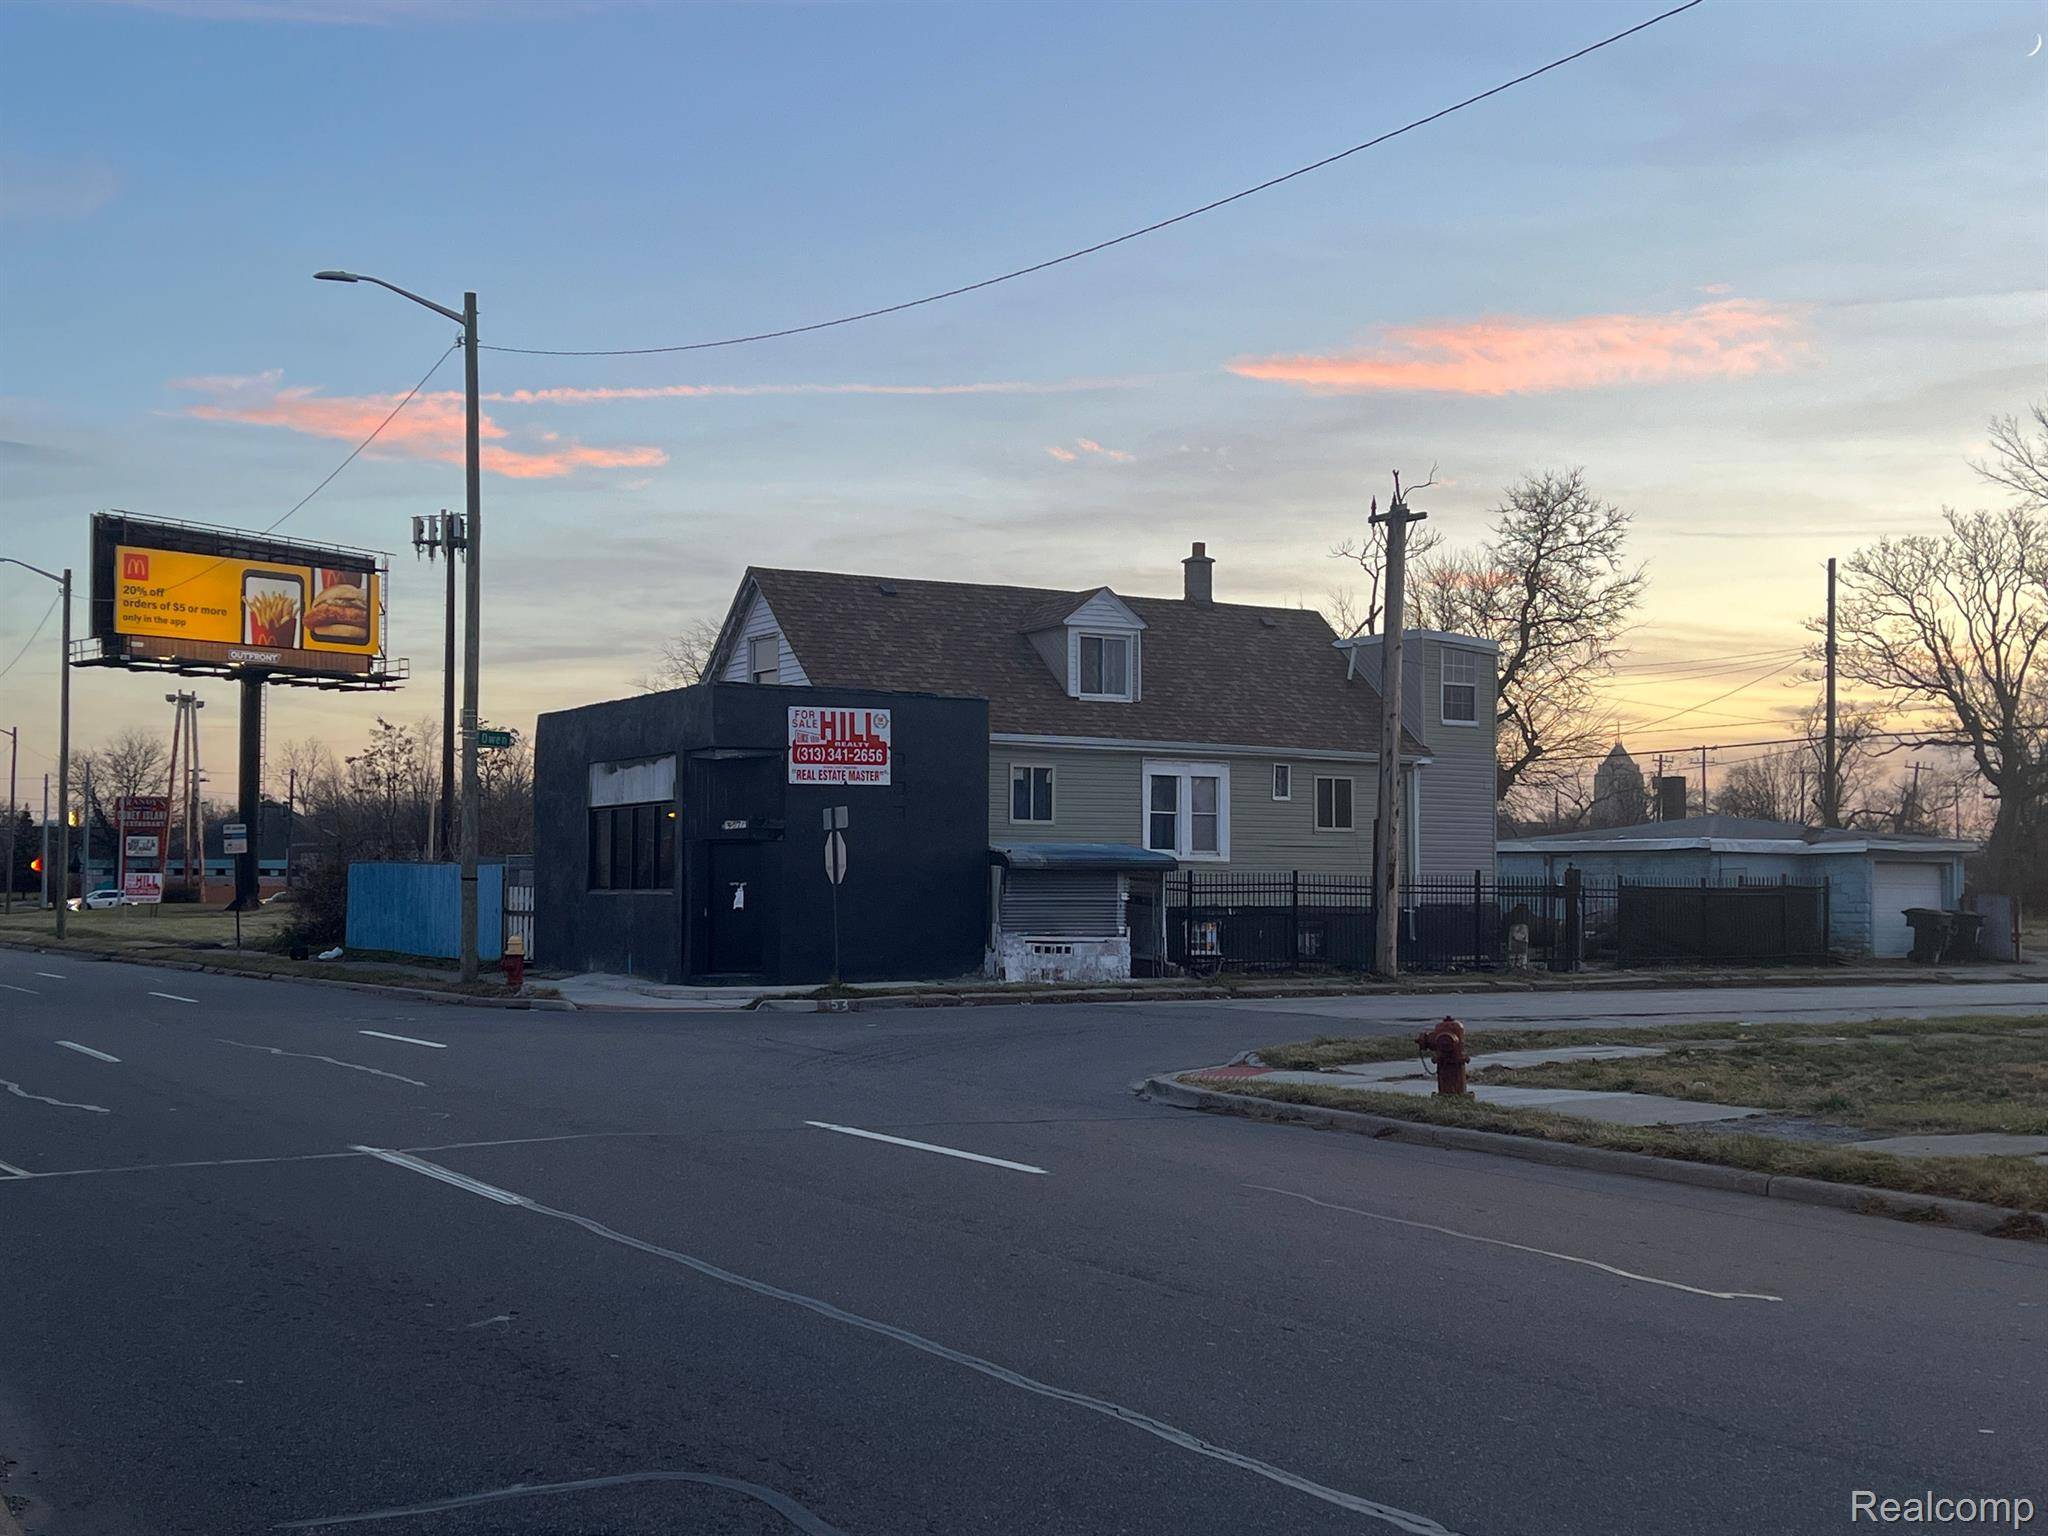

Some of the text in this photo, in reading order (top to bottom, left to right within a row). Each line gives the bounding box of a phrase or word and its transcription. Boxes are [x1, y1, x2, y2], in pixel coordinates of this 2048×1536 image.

[123, 585, 165, 598] 20% off
[123, 599, 228, 616] orders of $5 or more
[123, 614, 187, 628] only in the app
[795, 710, 816, 719] FOR
[792, 719, 818, 729] SALE
[820, 711, 880, 741] HILL
[797, 747, 883, 762] (313) 341-2656
[818, 769, 846, 781] ESTATE
